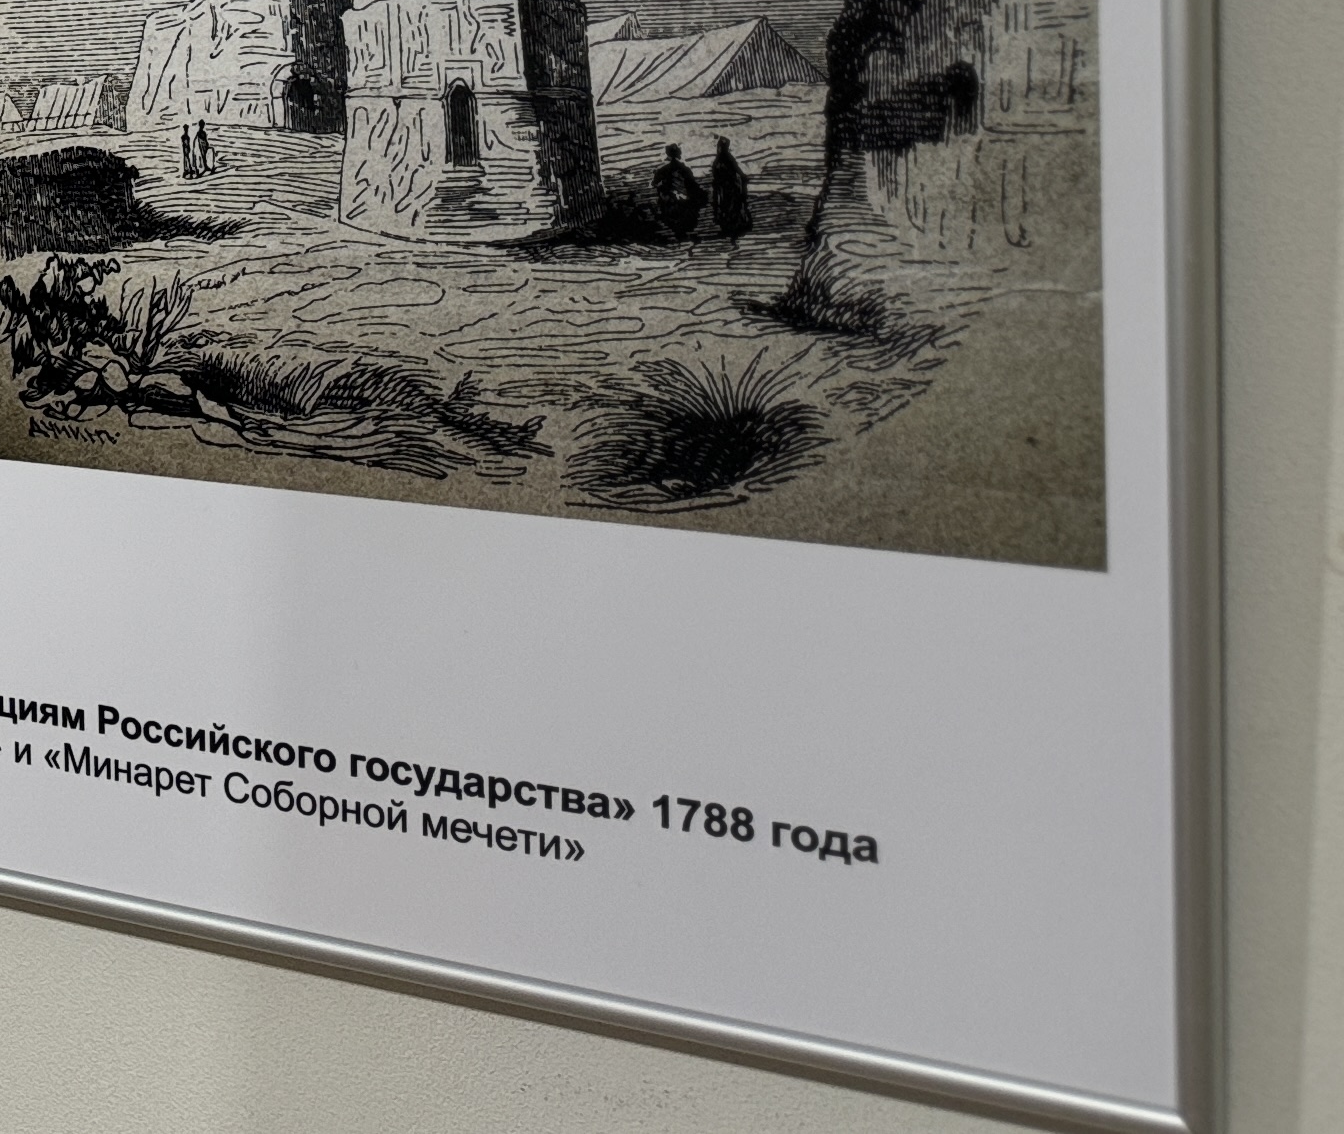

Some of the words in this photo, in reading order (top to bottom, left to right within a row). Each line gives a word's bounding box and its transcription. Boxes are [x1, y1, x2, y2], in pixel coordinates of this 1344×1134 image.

[14, 740, 32, 766] и
[43, 742, 213, 798] «Минарет
[223, 771, 408, 834] Соборной
[422, 812, 586, 862] мечети»
[97, 703, 337, 774] Российского
[349, 753, 636, 822] государства»
[652, 794, 755, 843] 1788
[771, 821, 879, 866] года
